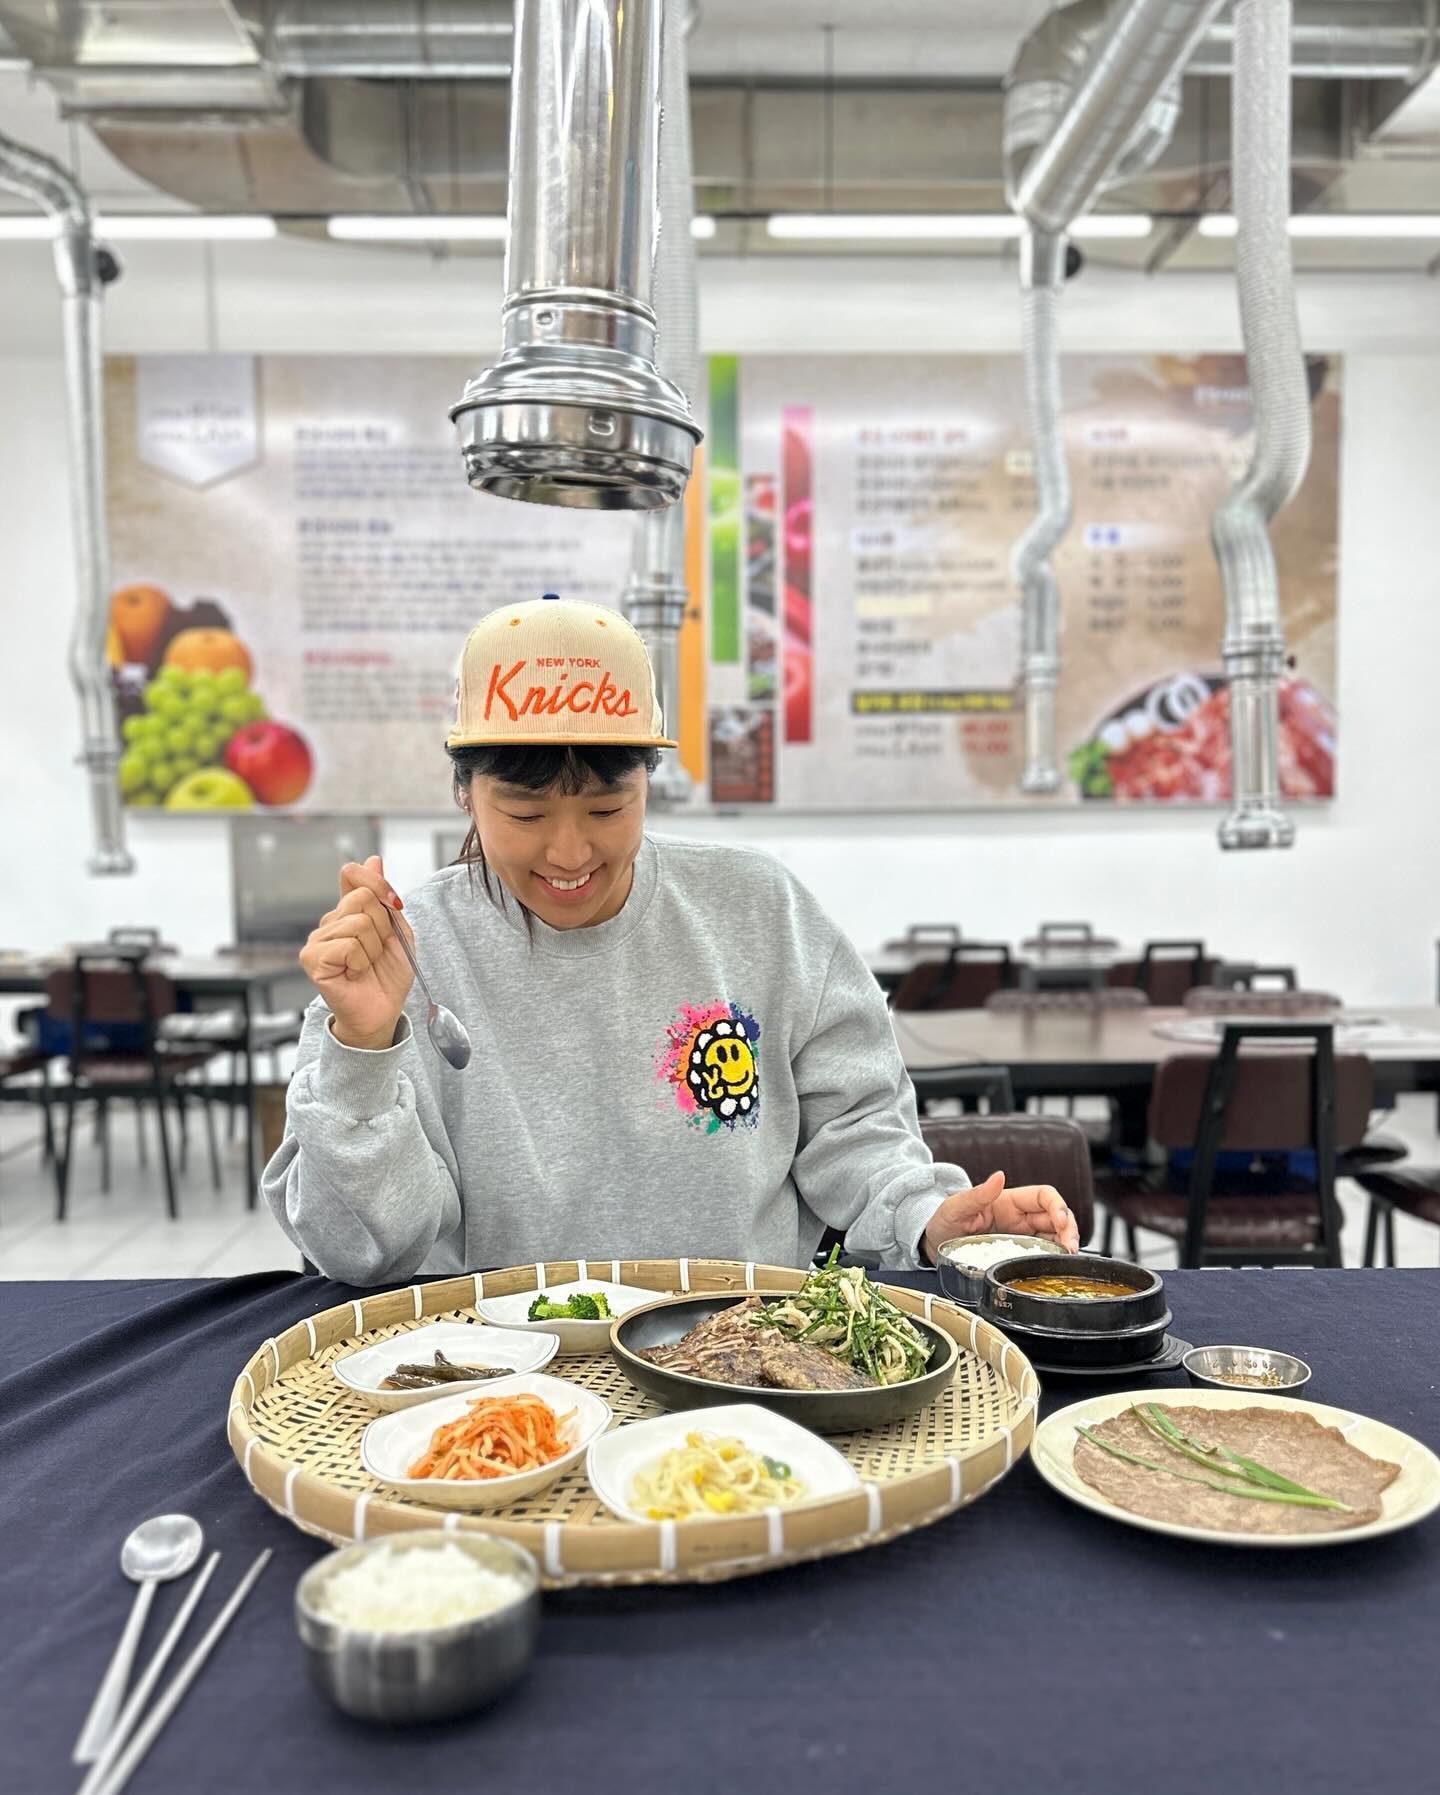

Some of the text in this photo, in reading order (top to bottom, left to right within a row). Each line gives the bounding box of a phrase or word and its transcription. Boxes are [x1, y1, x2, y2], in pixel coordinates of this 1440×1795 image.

[536, 657, 601, 668] NEW YORK
[484, 660, 639, 721] Knicks
